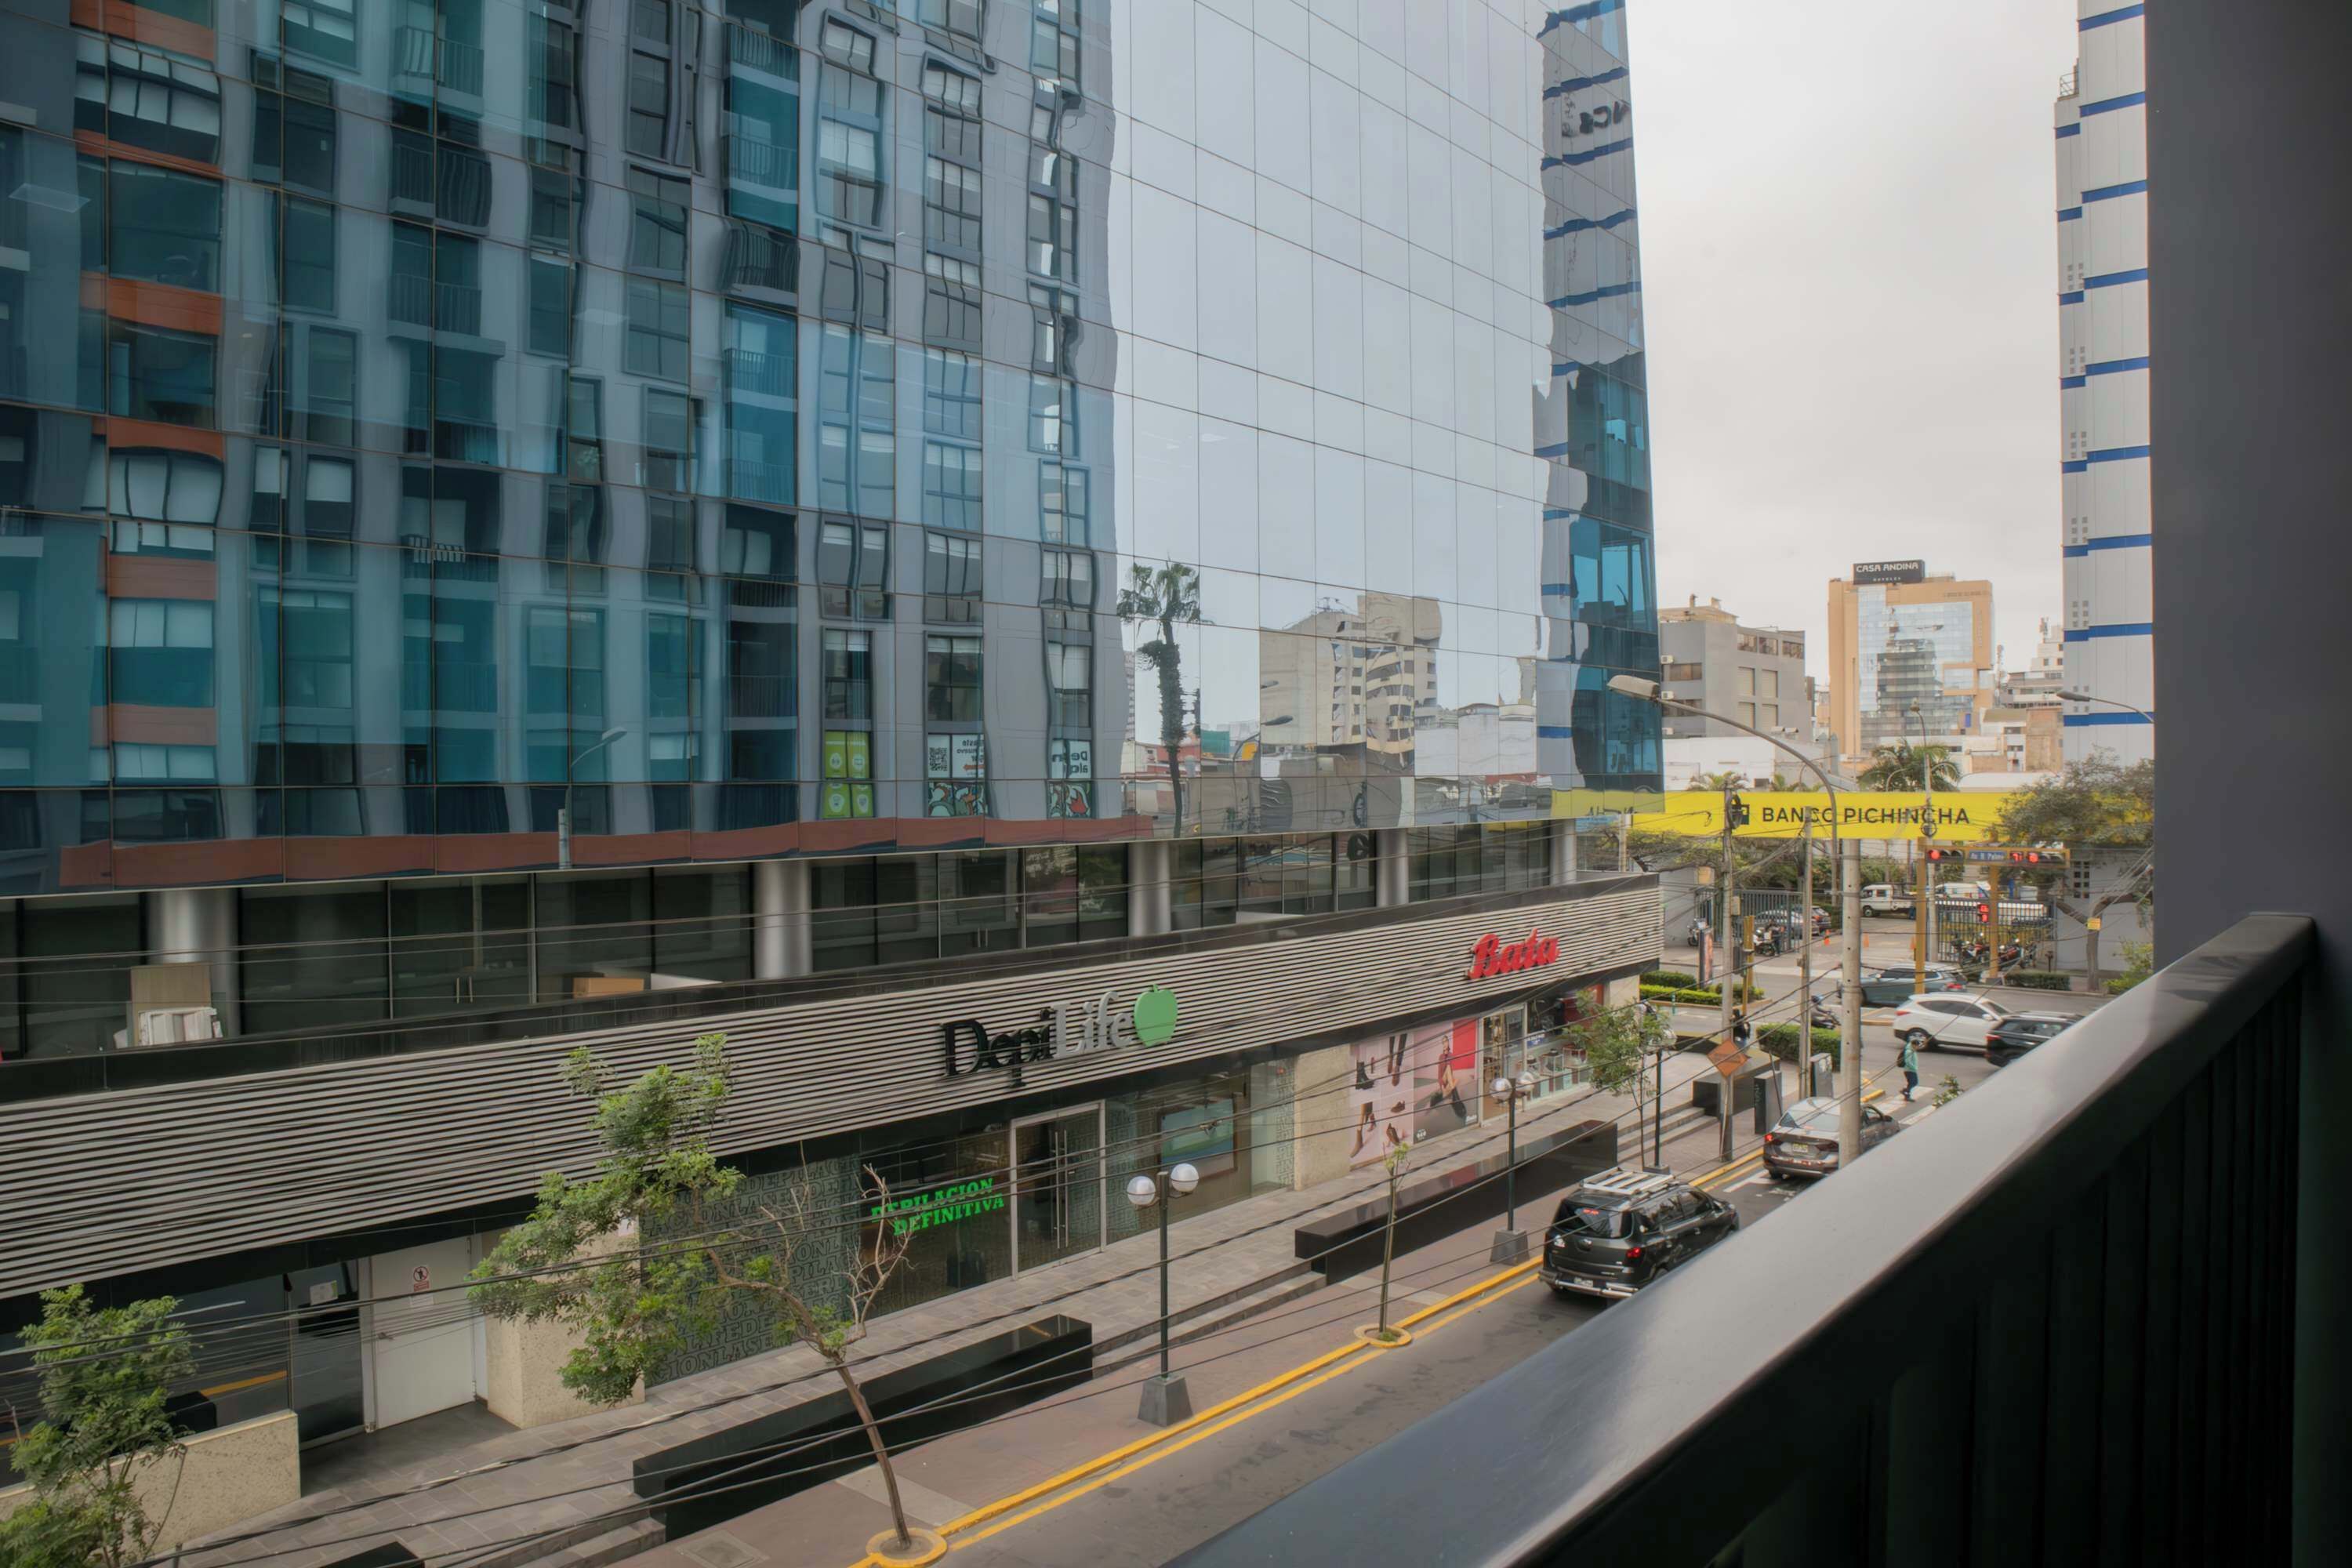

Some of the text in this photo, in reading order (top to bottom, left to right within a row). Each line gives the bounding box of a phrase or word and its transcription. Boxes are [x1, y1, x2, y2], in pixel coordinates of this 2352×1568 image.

[1882, 562, 1918, 571] ANDINA
[1844, 808, 1969, 823] PICHINCHA
[1467, 927, 1561, 979] Bata
[894, 1192, 1004, 1236] DEFINITIVA
